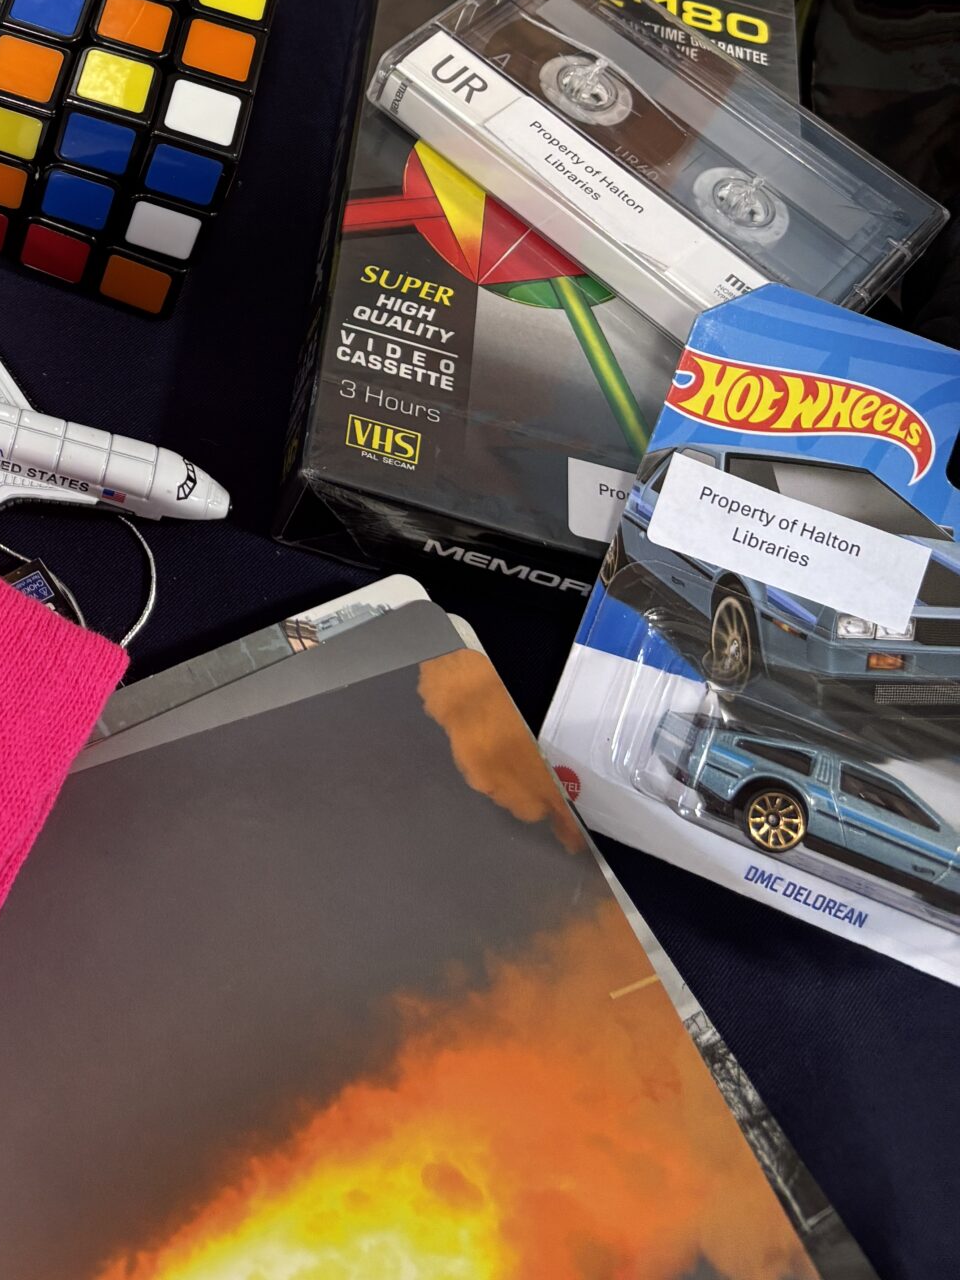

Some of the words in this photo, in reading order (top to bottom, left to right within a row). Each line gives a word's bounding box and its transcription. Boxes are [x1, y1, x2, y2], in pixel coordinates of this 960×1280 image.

[431, 54, 488, 104] UR
[529, 119, 584, 172] Property
[584, 163, 603, 180] of
[599, 176, 645, 215] Halton
[544, 153, 601, 202] Libraries
[360, 265, 455, 308] SUPER
[376, 293, 436, 321] HIGH
[352, 305, 456, 344] QUALITY
[336, 345, 455, 392] CASSETTE
[339, 379, 356, 399] 3
[365, 386, 441, 423] Hours
[353, 418, 417, 460] VHS
[361, 450, 378, 462] PAL
[382, 455, 416, 471] SECAM
[26, 467, 90, 493] STATES
[700, 486, 775, 526] Property
[779, 516, 798, 532] of
[799, 521, 862, 558] Halton
[732, 526, 810, 568] Libraries
[744, 865, 783, 893] DMC
[782, 881, 870, 929] DELOREAN
